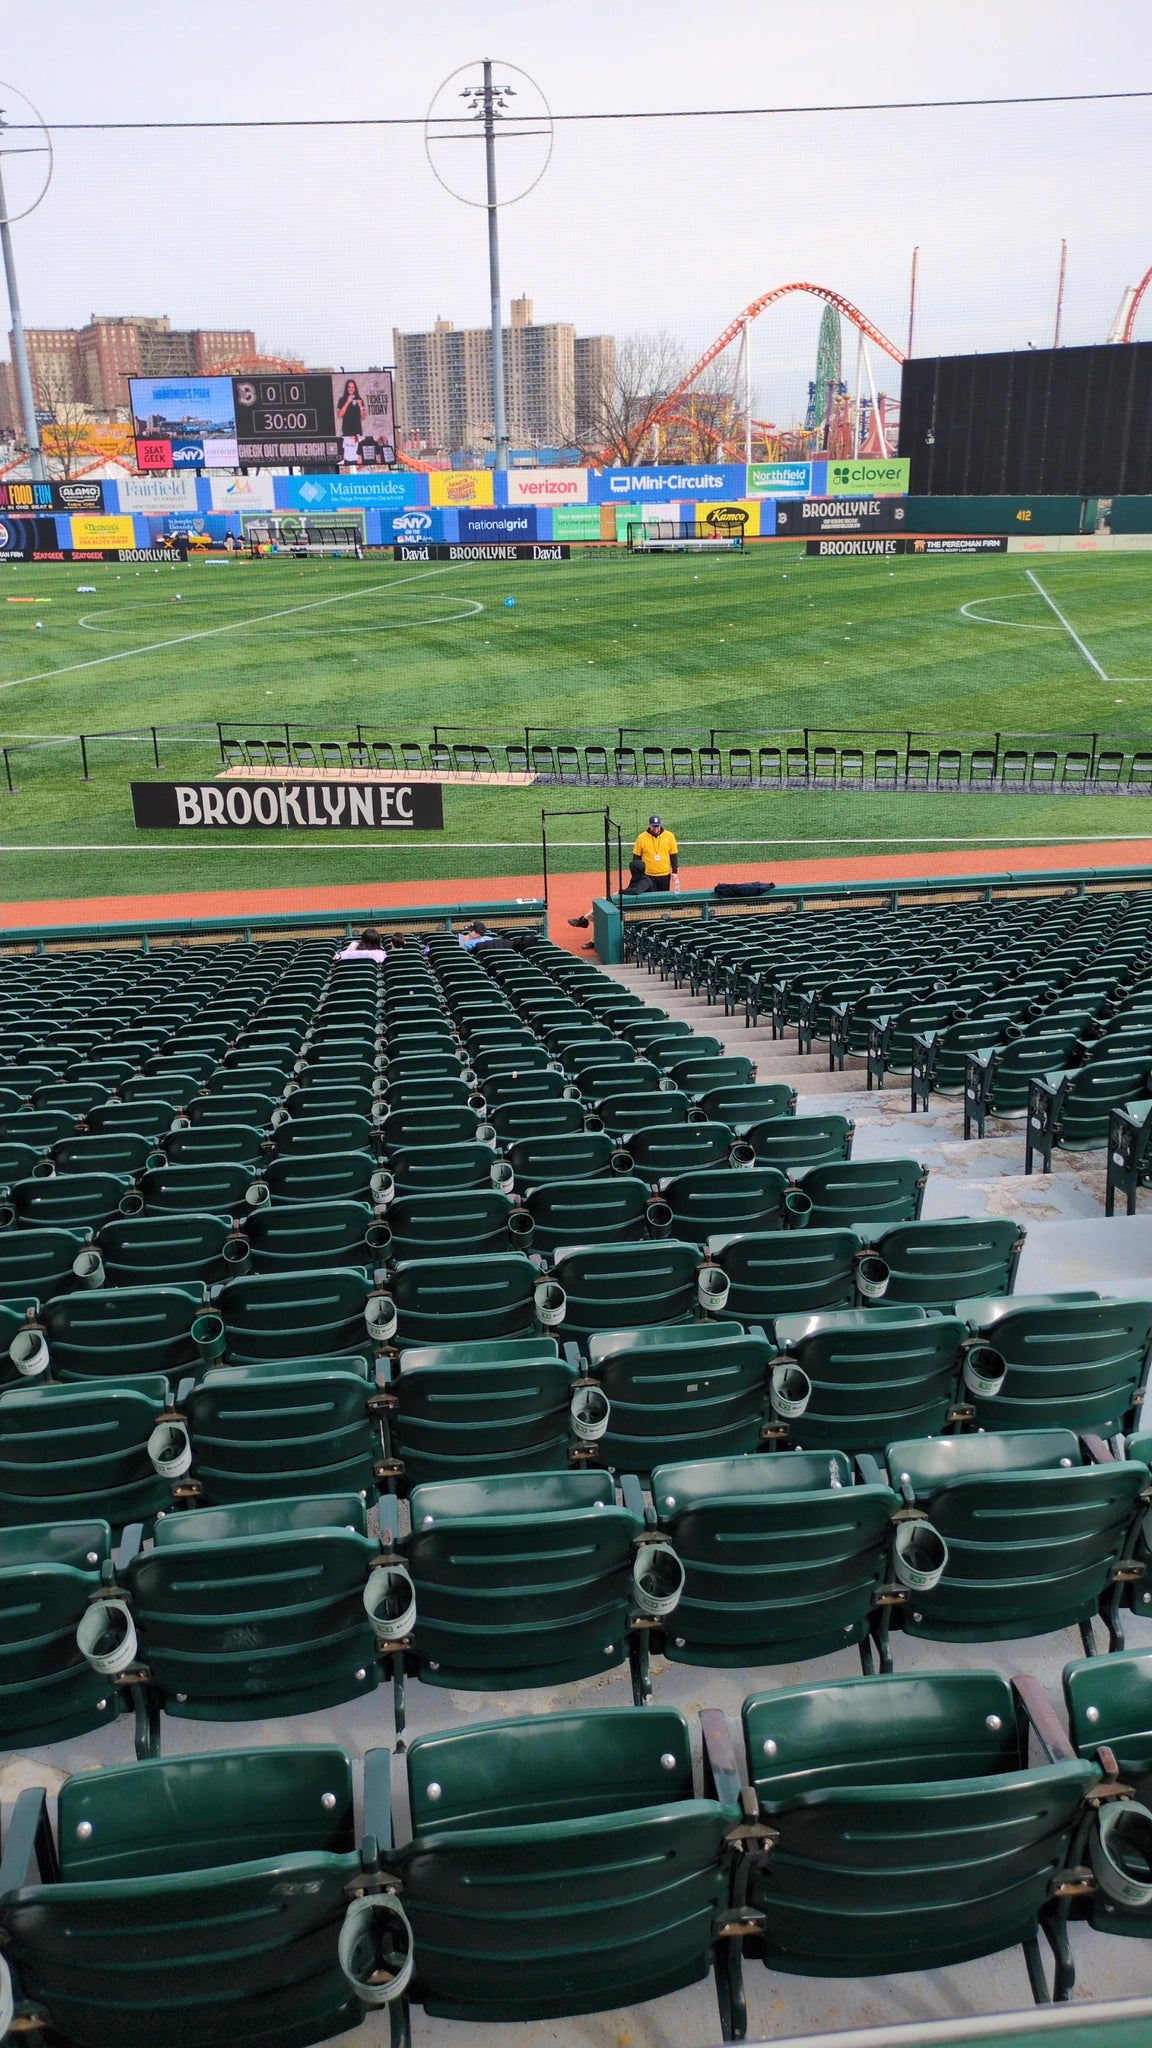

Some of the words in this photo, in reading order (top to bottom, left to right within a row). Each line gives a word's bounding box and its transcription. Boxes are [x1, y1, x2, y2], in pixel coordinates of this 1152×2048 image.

[266, 386, 276, 401] 0
[290, 385, 300, 401] 0
[366, 394, 388, 404] TICKETS
[367, 404, 388, 416] TODAY
[264, 413, 307, 430] 30:00
[144, 446, 164, 455] SEAT
[172, 450, 201, 461] SNY
[238, 444, 264, 458] CHECK
[264, 443, 279, 457] OUT
[279, 443, 295, 457] OUR
[296, 442, 326, 456] MERCH!
[144, 454, 166, 463] GEEK
[752, 469, 806, 481] Northfield
[851, 466, 902, 481] clover
[125, 480, 186, 497] Fairfield
[329, 480, 405, 495] Maimonides
[518, 479, 578, 494] verizon
[631, 475, 724, 490] Mini-Circuits
[8, 484, 33, 505] FOOD
[33, 484, 52, 505] FUN
[63, 487, 97, 496] ALAMO
[711, 508, 746, 522] Kamco
[802, 502, 869, 518] BROOKLYN
[869, 501, 881, 515] FC
[1016, 510, 1032, 521] 412
[270, 517, 309, 538] TGI
[391, 514, 428, 530] SNY
[468, 518, 528, 531] nationalgrid
[820, 540, 884, 555] BROOKLYN
[885, 540, 897, 554] FC
[982, 539, 1000, 547] FIRM
[32, 551, 65, 560] SEATGEEK
[71, 551, 104, 560] SEATGEEK
[118, 550, 171, 562] BROOKLYN
[171, 550, 181, 561] FC
[401, 546, 430, 561] David
[449, 546, 507, 560] BROOKLYN
[507, 546, 518, 559] FC
[533, 545, 562, 560] David
[174, 786, 376, 826] BROOKLYN
[379, 786, 414, 824] FC
